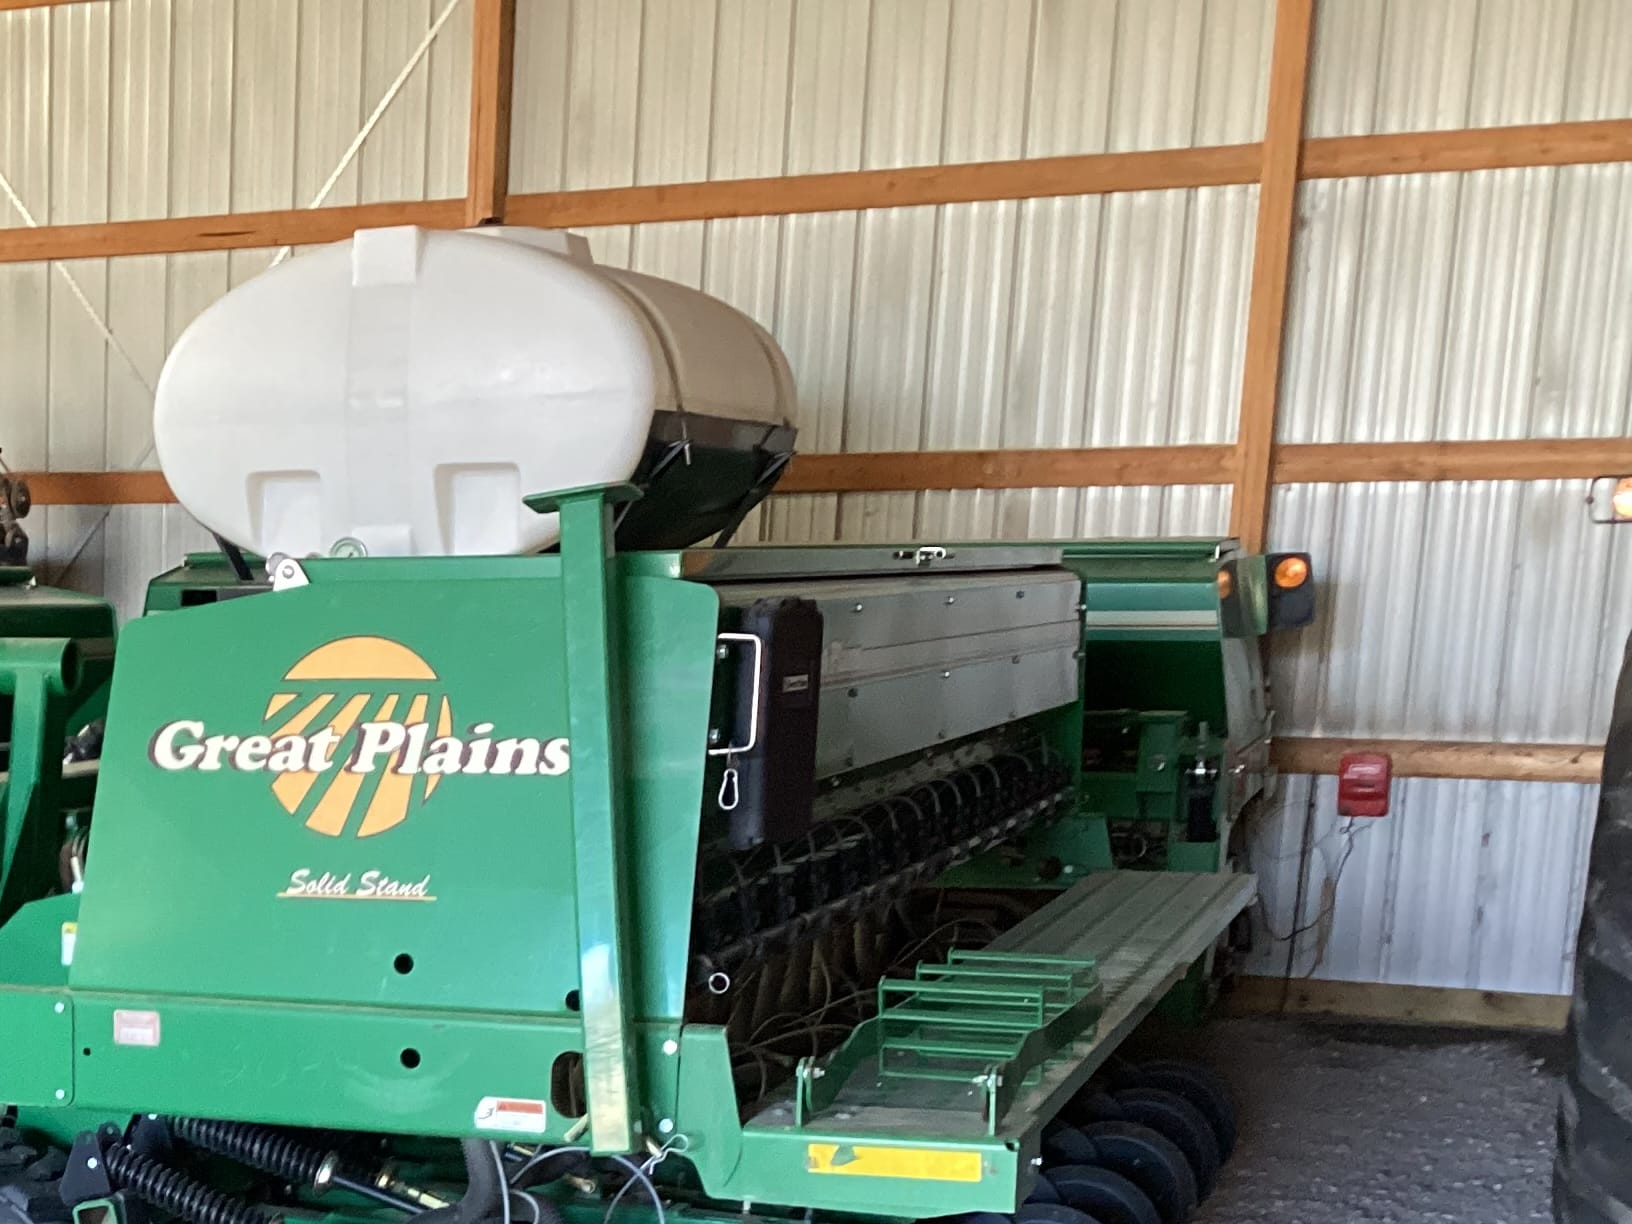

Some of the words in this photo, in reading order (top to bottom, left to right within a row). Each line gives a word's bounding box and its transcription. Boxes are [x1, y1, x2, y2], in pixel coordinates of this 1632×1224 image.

[149, 720, 341, 772] Great
[347, 722, 570, 775] Plains
[286, 868, 352, 896] Solid
[356, 870, 431, 897] Stand
